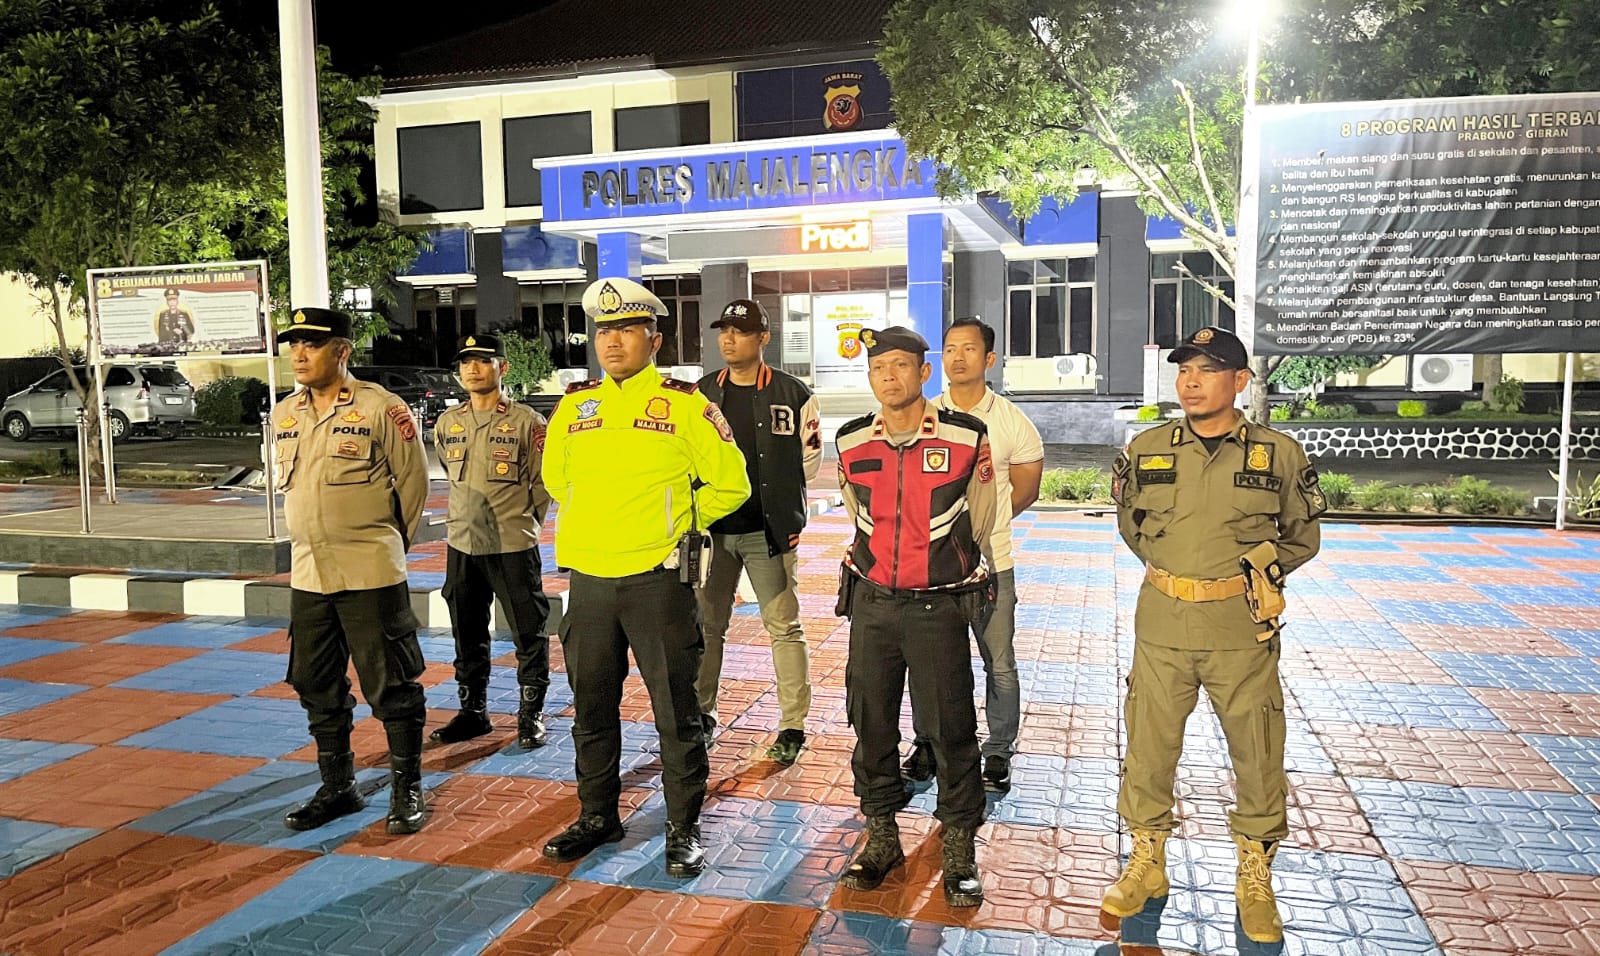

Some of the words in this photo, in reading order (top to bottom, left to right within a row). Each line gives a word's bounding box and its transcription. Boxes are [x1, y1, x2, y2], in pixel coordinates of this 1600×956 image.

[1341, 122, 1351, 137] 8
[1356, 117, 1457, 137] PROGRAM
[1463, 114, 1522, 131] HASIL
[1458, 130, 1515, 141] PRABOWO
[1525, 129, 1569, 139] GIBRAN
[1327, 154, 1359, 165] makan
[1362, 153, 1387, 164] siang
[1391, 152, 1408, 161] dan
[1438, 149, 1464, 161] gratis
[1467, 149, 1476, 157] di
[1479, 146, 1517, 157] sekolah
[1520, 146, 1538, 155] dan
[583, 163, 694, 208] POLRES
[706, 147, 922, 200] MAJALENGKA
[1310, 168, 1328, 179] dan
[1348, 166, 1374, 176] hamil
[1282, 179, 1371, 193] Menyelenggarakan
[1440, 175, 1491, 185] kesehatan
[1527, 171, 1588, 182] menurunkan
[1281, 197, 1299, 206] dan
[1302, 194, 1337, 207] bangun
[1340, 194, 1355, 202] RS
[1358, 191, 1395, 203] lengkap
[1455, 189, 1463, 197] di
[1466, 187, 1517, 198] kabupaten
[1281, 207, 1327, 218] Mencetak
[1329, 206, 1347, 216] dan
[1350, 203, 1417, 216] meningkatkan
[1420, 201, 1482, 213] produktivitas
[1485, 200, 1512, 209] lahan
[1515, 199, 1561, 210] pertanian
[1281, 221, 1298, 231] dan
[1301, 220, 1341, 230] nasional
[1280, 234, 1338, 244] Membangun
[1422, 228, 1455, 240] unggul
[1458, 227, 1513, 238] terintegrasi
[1516, 226, 1525, 235] di
[1528, 226, 1557, 236] setiap
[1280, 246, 1316, 256] sekolah
[1318, 246, 1341, 256] yang
[1344, 244, 1368, 255] perlu
[1371, 243, 1412, 253] renovasi
[1280, 259, 1336, 270] Melanjutkan
[1339, 258, 1356, 267] dan
[1434, 255, 1474, 265] program
[1478, 252, 1531, 263] kartu-kartu
[1279, 272, 1350, 282] menghilangkan
[1353, 269, 1407, 280] kemiskinan
[97, 278, 113, 298] 8
[166, 273, 211, 285] KAPOLDA
[213, 272, 245, 283] JABAR
[1350, 283, 1373, 292] ASN
[1452, 280, 1485, 290] dosen,
[1489, 280, 1507, 288] dan
[1510, 280, 1544, 289] tenaga
[1278, 297, 1334, 308] Melanjutkan
[1337, 295, 1405, 306] pembangunan
[1499, 292, 1540, 301] Bantuan
[1544, 291, 1592, 302] Langsung
[1278, 309, 1307, 319] rumah
[1310, 309, 1339, 318] murah
[1342, 306, 1394, 318] bersanitasi
[1397, 305, 1417, 316] baik
[1420, 306, 1447, 316] untuk
[1450, 306, 1473, 317] yang
[1476, 305, 1547, 315] membutuhkan
[1277, 322, 1328, 332] Mendirikan
[1330, 321, 1361, 331] Badan
[1364, 320, 1422, 331] Penerimaan
[1425, 320, 1461, 331] Negara
[1464, 319, 1482, 328] dan
[1486, 318, 1554, 329] meningkatkan
[1558, 318, 1582, 327] rasio
[1277, 334, 1318, 345] domestik
[1321, 333, 1345, 344] bruto
[1347, 333, 1377, 344] (PDB)
[1379, 333, 1391, 343] ke
[1393, 333, 1415, 342] 23%
[773, 406, 793, 433] R
[332, 426, 371, 436] POLRI
[490, 436, 518, 445] POLRI
[1239, 475, 1264, 487] POL
